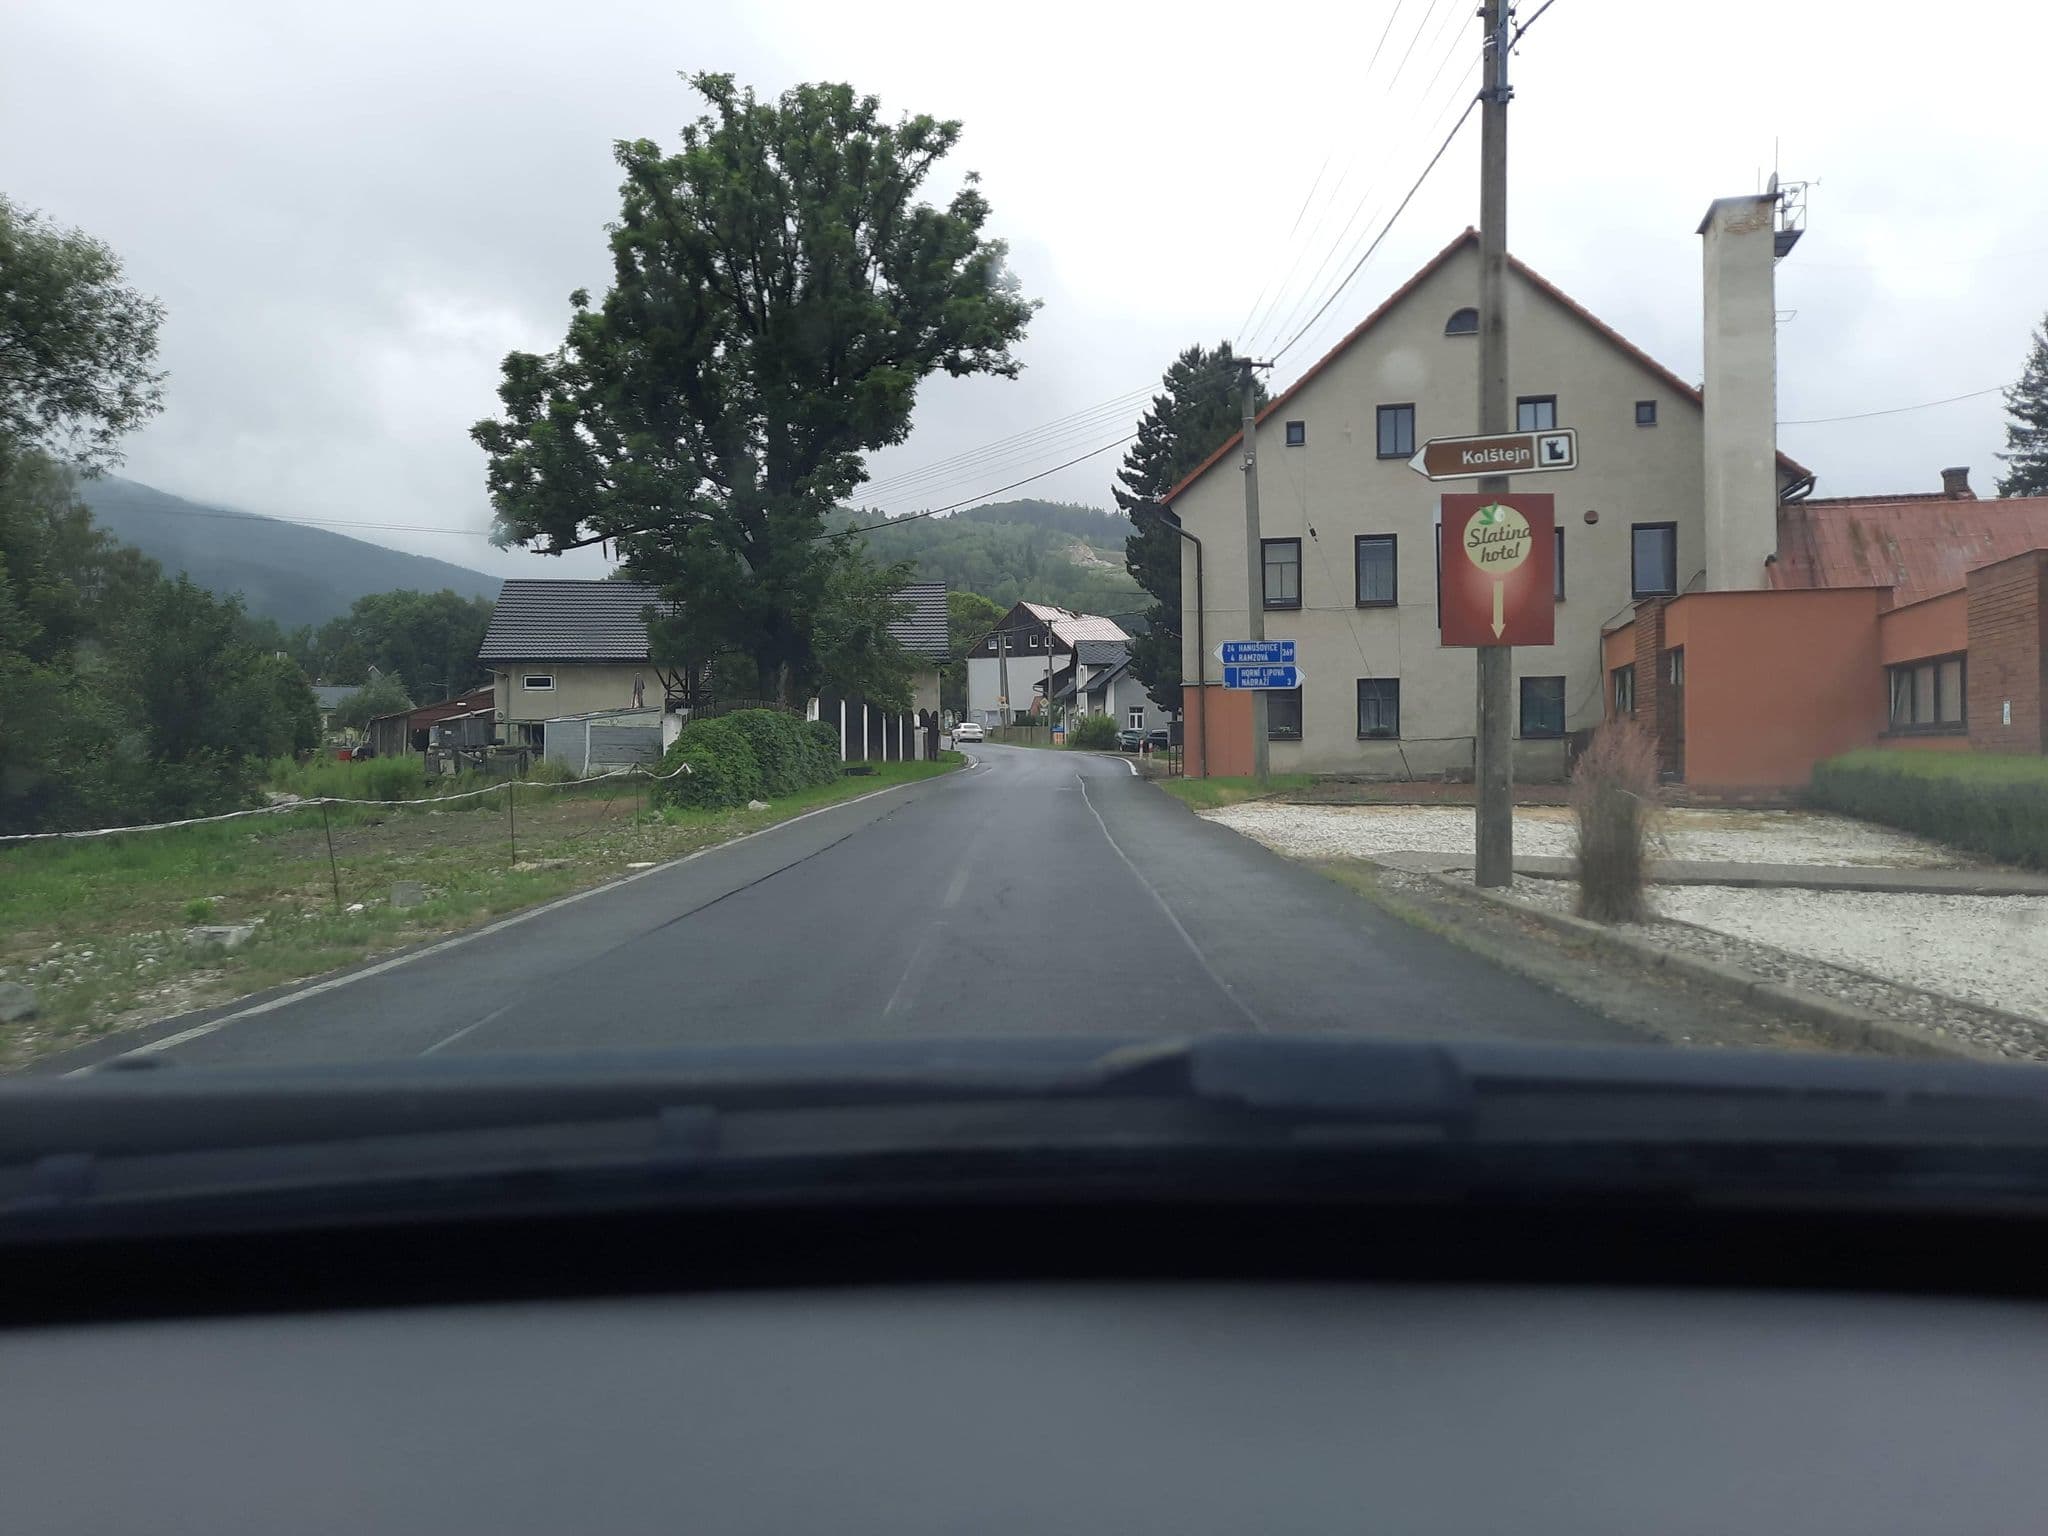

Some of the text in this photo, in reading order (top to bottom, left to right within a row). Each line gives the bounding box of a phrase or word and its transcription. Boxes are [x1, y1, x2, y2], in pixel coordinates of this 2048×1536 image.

[1461, 446, 1530, 466] Kolštejn
[1467, 523, 1533, 548] Slatina
[1480, 542, 1520, 563] hotel
[1227, 642, 1278, 652] 24 HANUŠOVICE
[1238, 652, 1269, 661] RAMZOVÁ
[1262, 667, 1285, 676] LIPOVÁ
[1241, 676, 1270, 686] NÁDRAŽÍ
